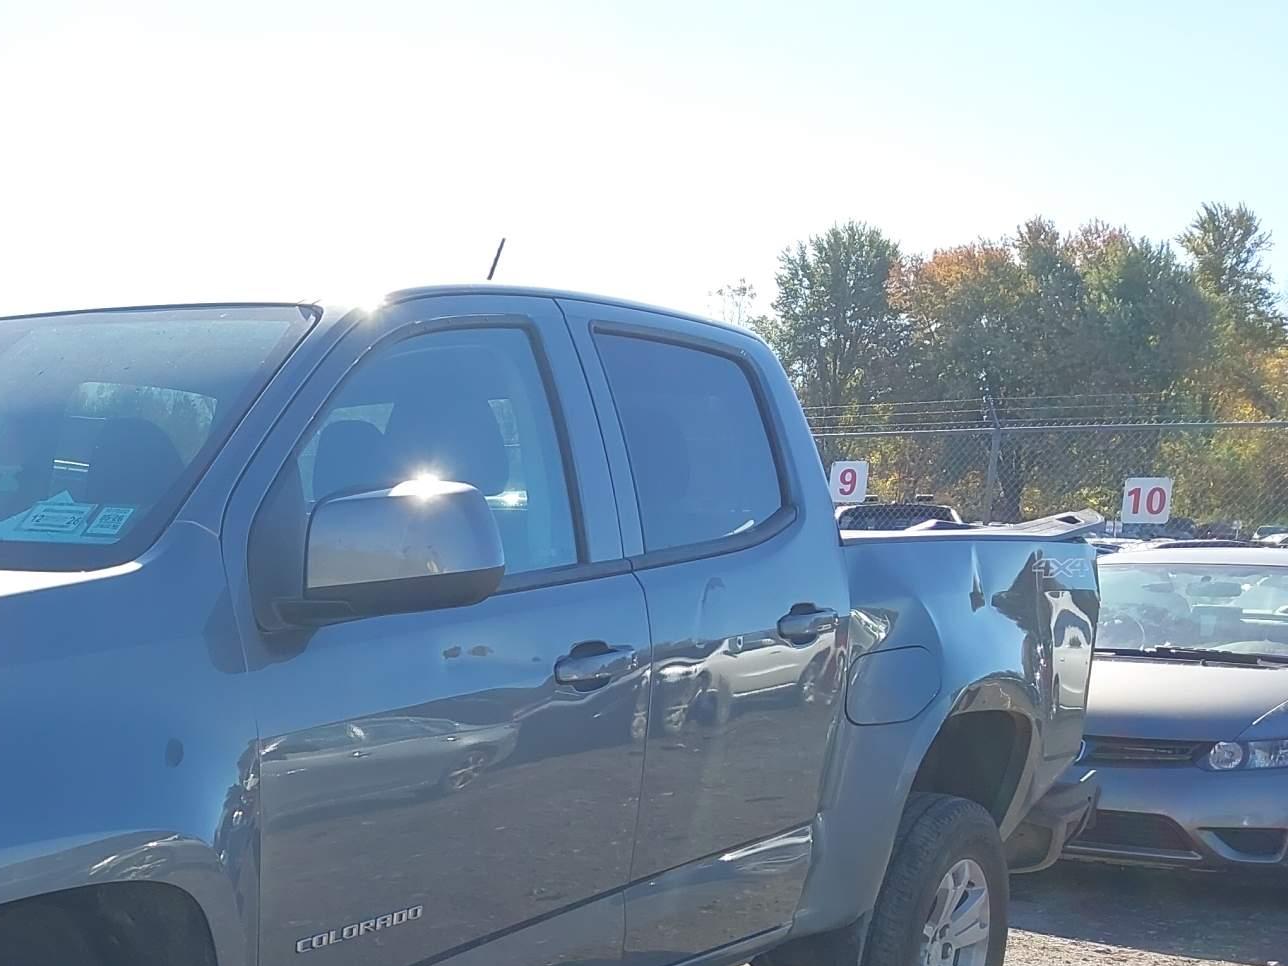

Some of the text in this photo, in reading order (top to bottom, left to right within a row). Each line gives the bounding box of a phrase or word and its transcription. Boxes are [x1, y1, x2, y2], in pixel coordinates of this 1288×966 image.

[838, 468, 858, 496] 9
[1127, 486, 1167, 515] 10
[296, 905, 423, 953] COLORADO
